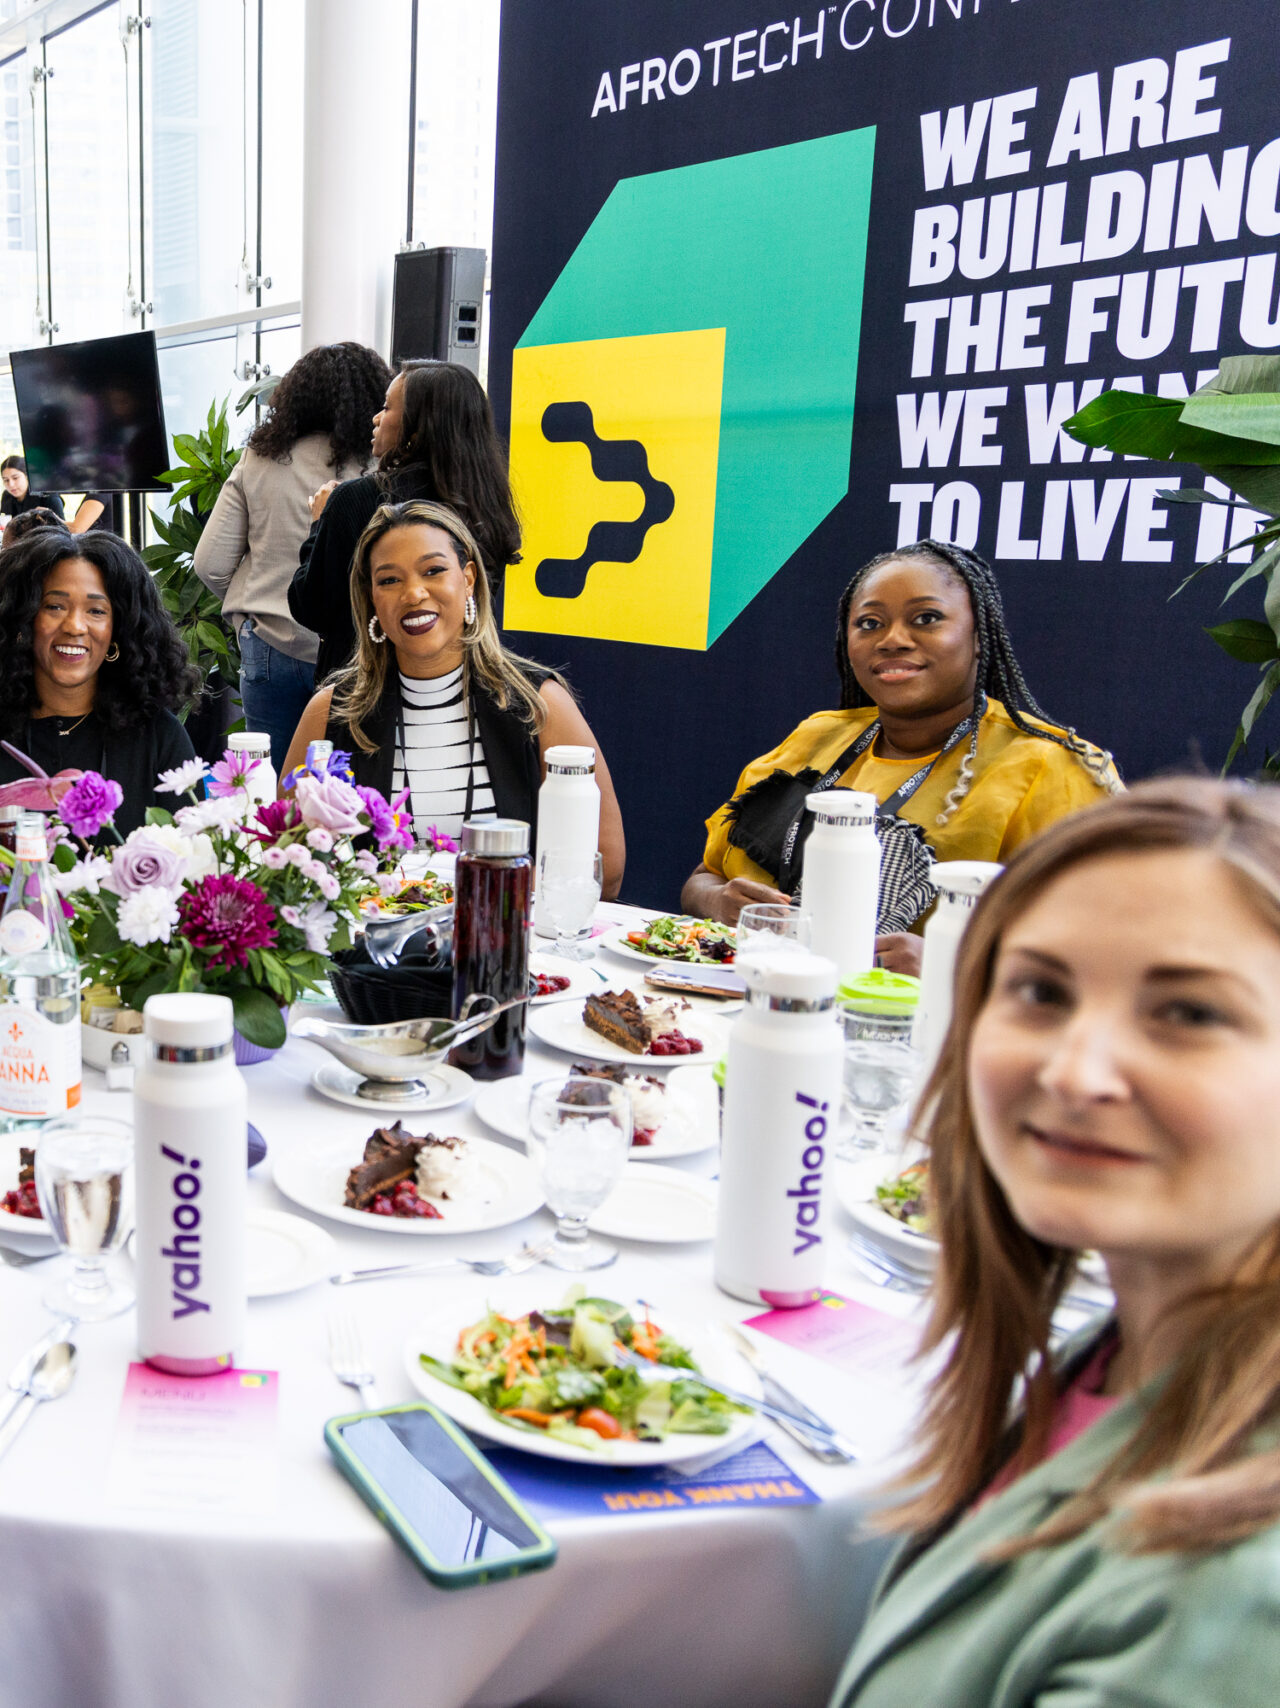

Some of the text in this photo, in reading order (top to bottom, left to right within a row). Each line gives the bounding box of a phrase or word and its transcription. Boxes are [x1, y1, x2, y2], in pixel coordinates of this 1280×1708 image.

[920, 37, 1231, 192] WE ARE
[903, 284, 1052, 379] THE
[896, 386, 1009, 469] WE
[888, 480, 982, 553] TO
[994, 476, 1182, 563] LIVE
[897, 764, 931, 798] AFROTECH
[784, 821, 801, 865] AFROTECH
[786, 1090, 829, 1256] yahoo!
[161, 1143, 211, 1321] yahoo!
